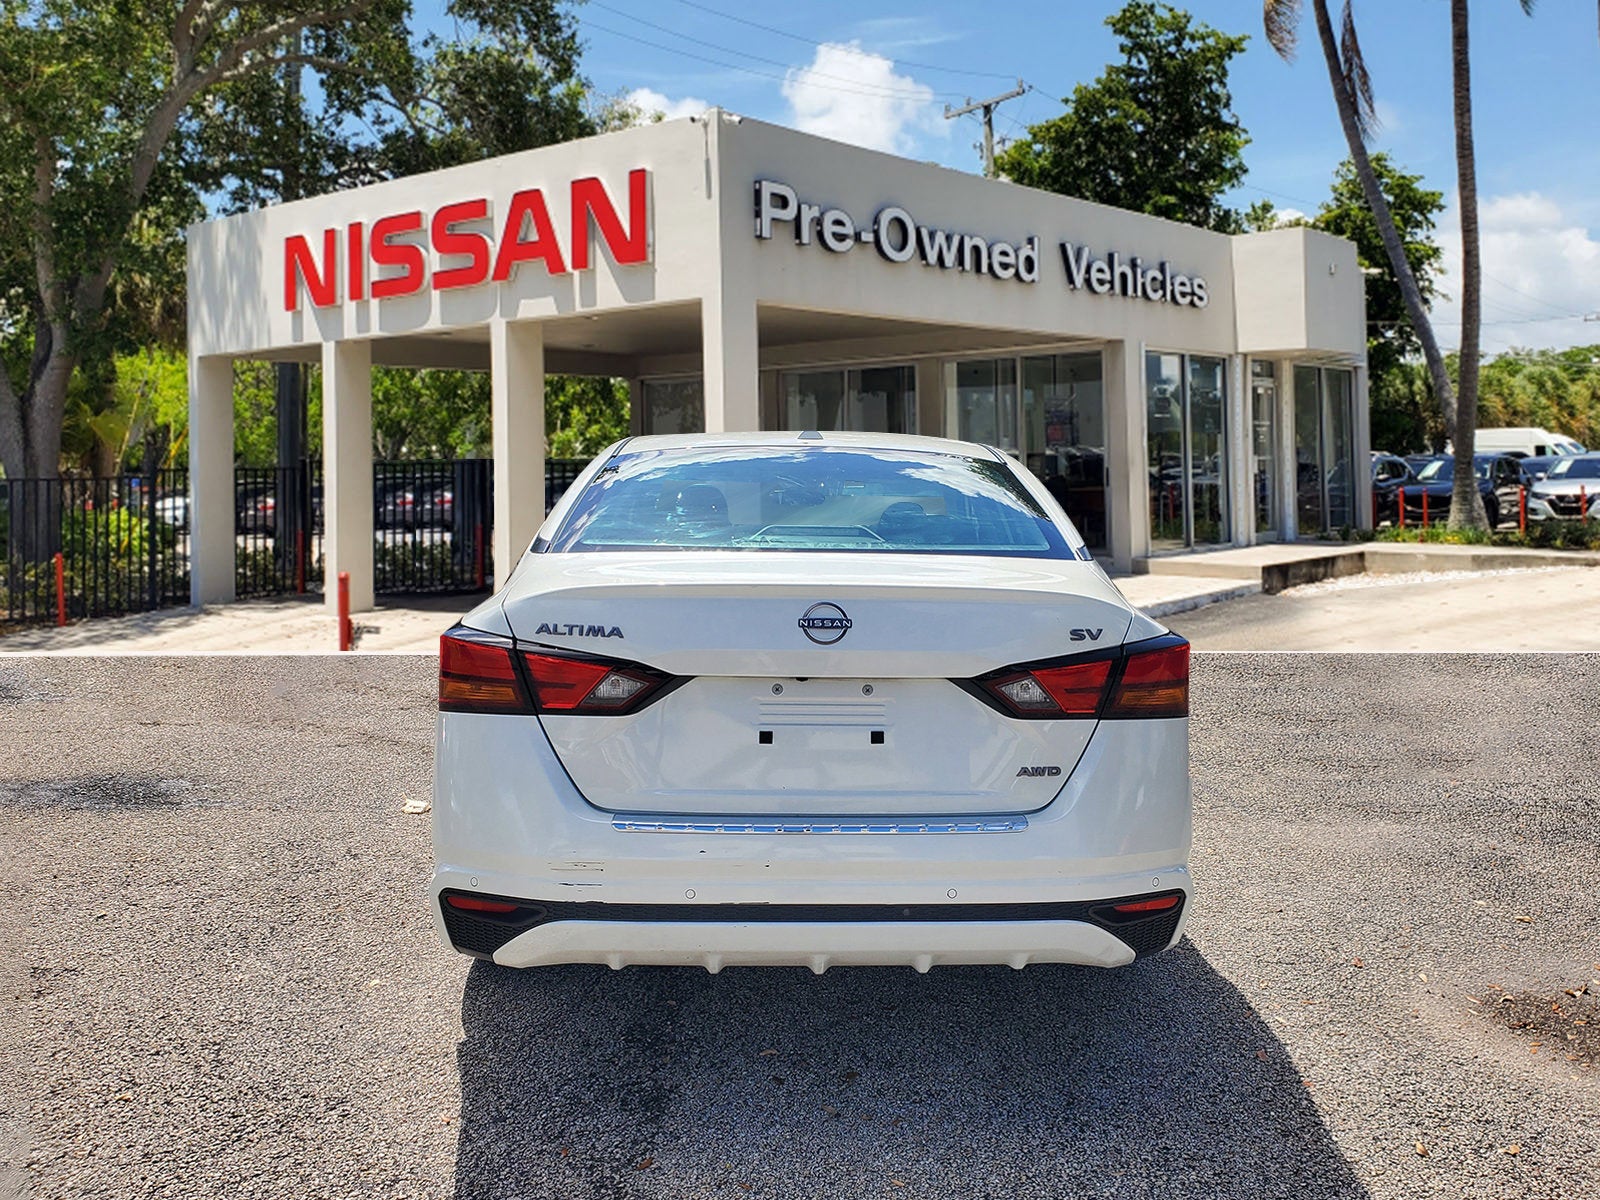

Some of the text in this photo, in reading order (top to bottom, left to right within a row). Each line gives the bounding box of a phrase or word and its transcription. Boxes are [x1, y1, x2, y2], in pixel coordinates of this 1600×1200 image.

[284, 168, 648, 312] NISSAN
[754, 179, 1209, 309] Pre-Owned Vehicles
[535, 621, 625, 639] ALTIMA
[799, 618, 852, 628] NISSAN
[1069, 628, 1104, 641] SV
[1016, 766, 1062, 777] AWD
